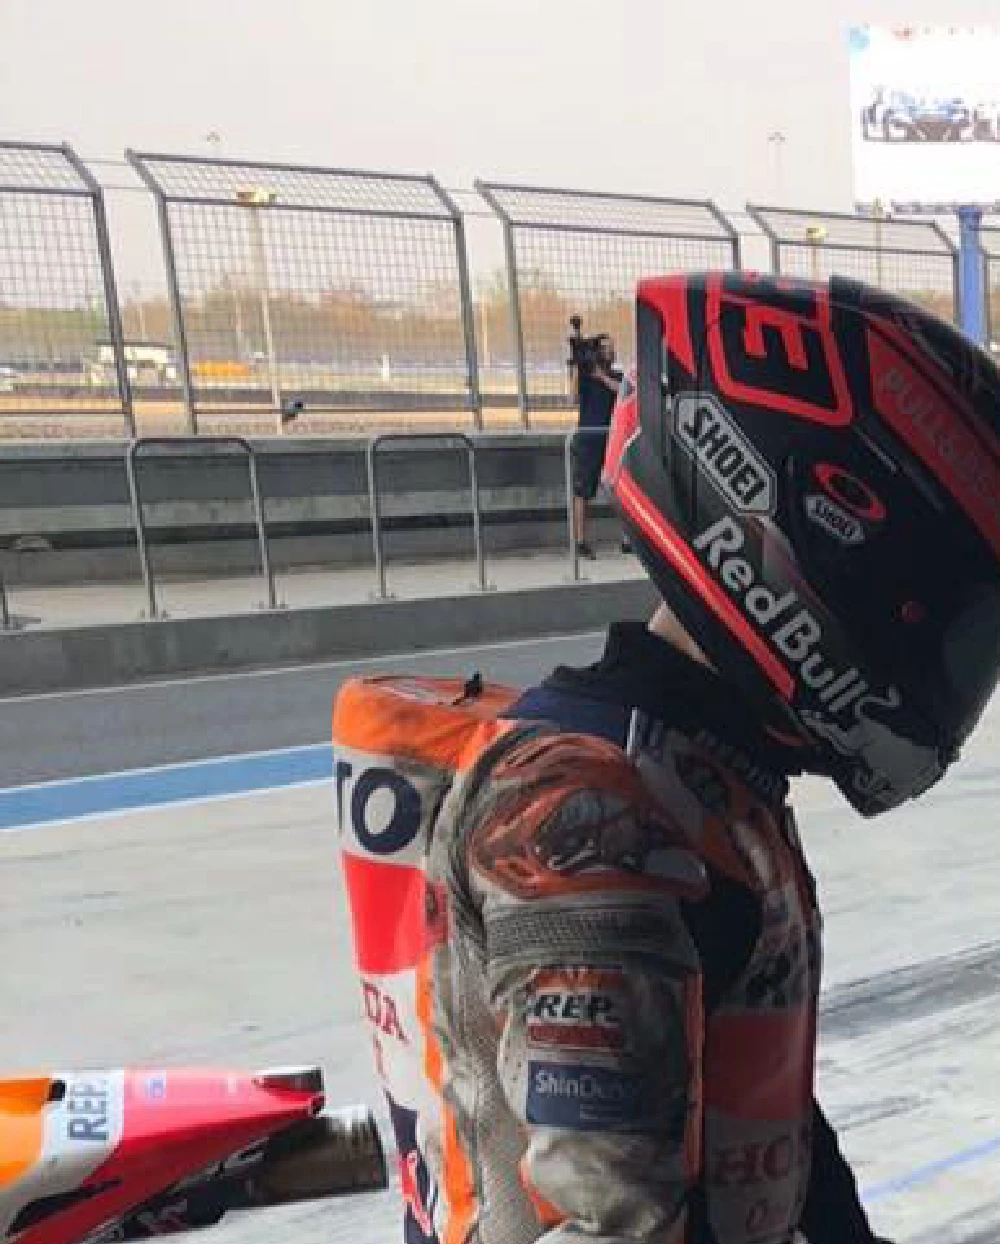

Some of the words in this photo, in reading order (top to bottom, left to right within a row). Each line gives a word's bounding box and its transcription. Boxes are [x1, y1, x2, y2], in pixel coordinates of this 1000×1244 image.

[684, 407, 767, 505] SHOEI
[694, 515, 799, 625] Red
[772, 610, 869, 713] Bull
